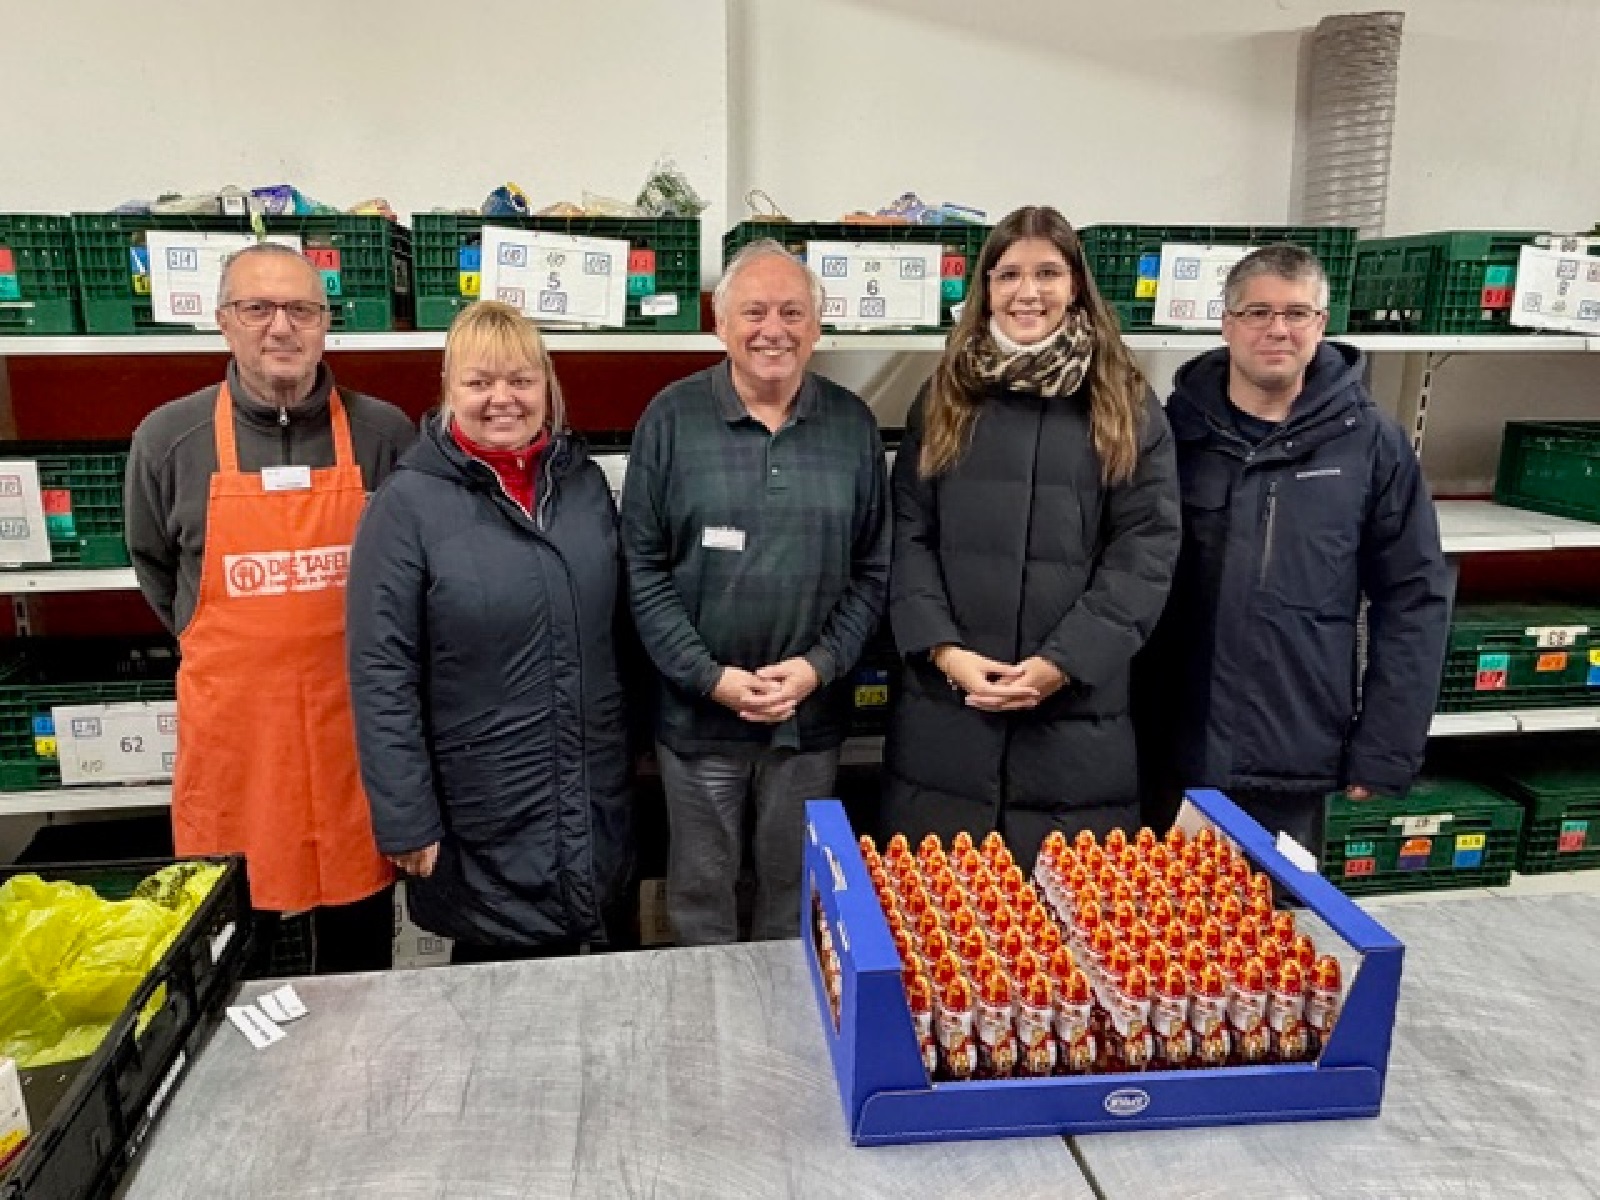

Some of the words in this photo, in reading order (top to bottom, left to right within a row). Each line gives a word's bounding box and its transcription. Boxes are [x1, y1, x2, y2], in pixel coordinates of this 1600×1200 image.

[546, 271, 561, 290] 5
[865, 278, 880, 296] 6
[120, 735, 145, 753] 62
